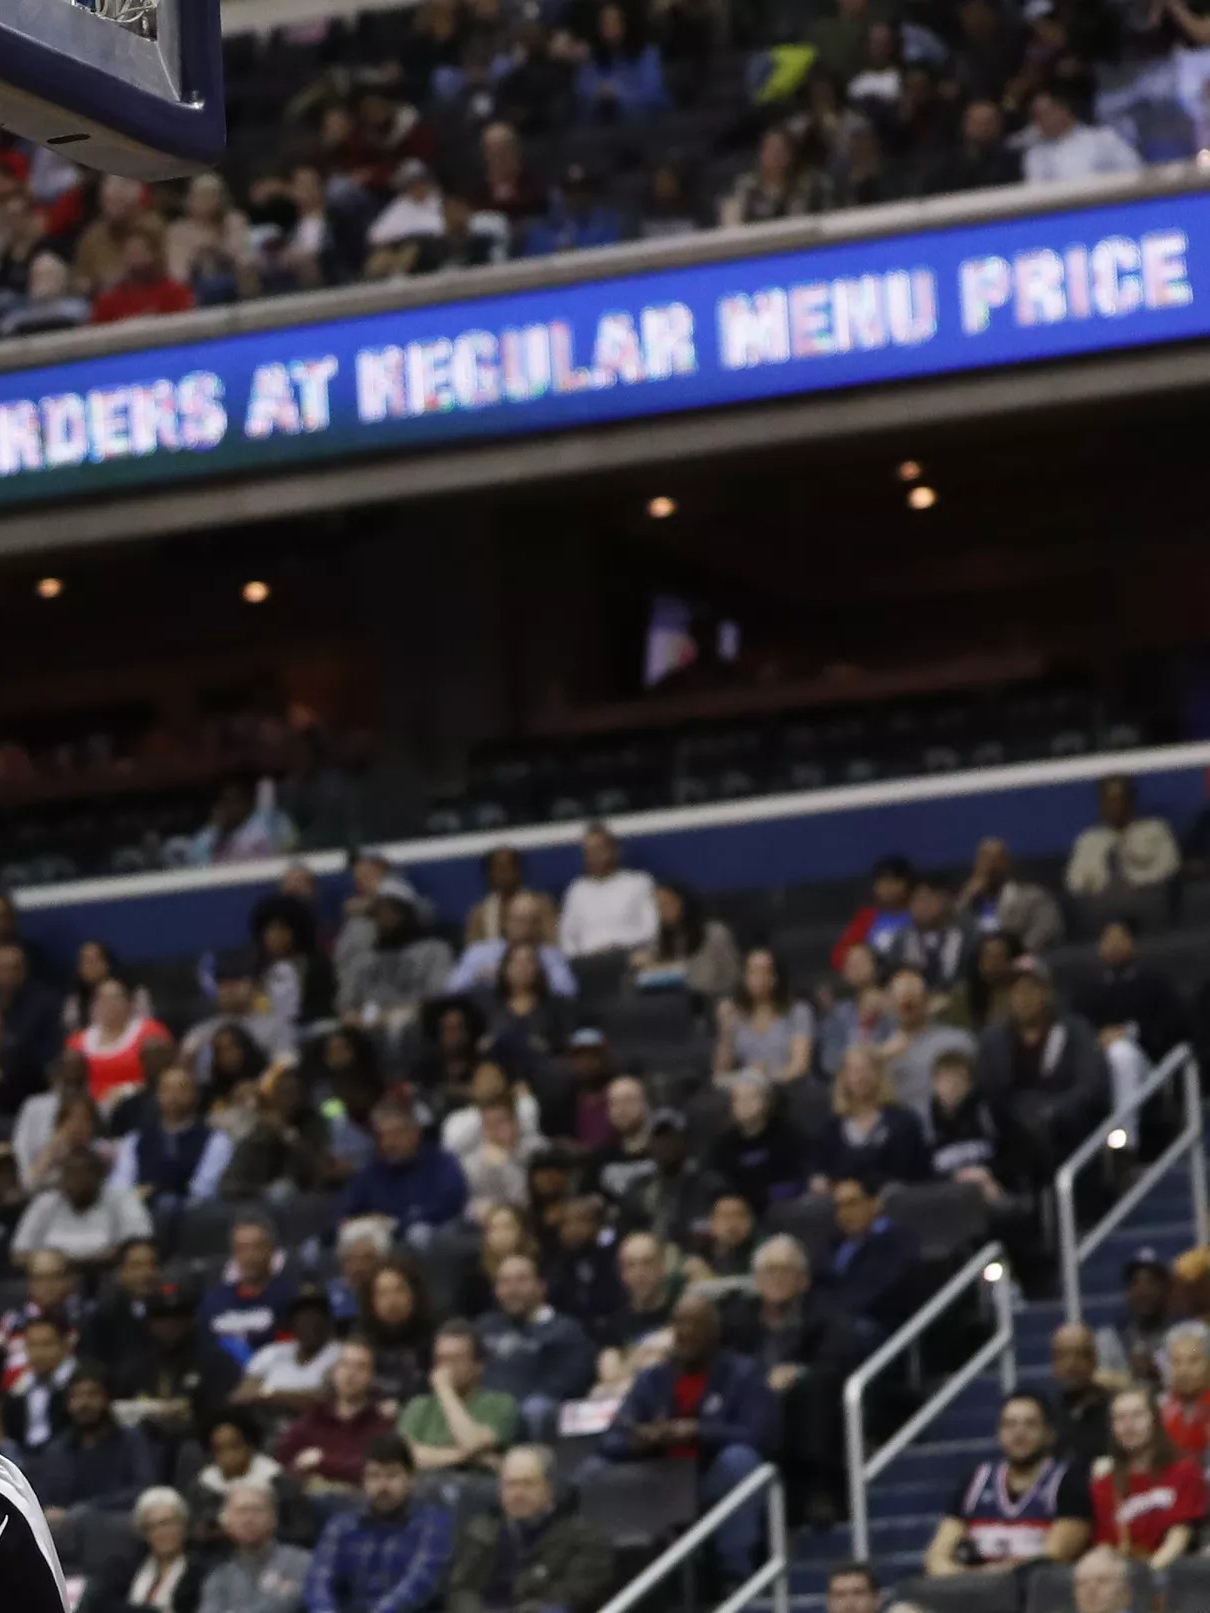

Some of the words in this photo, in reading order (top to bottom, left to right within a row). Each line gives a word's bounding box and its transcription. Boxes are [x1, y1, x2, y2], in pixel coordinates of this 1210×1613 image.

[244, 354, 339, 438] AT
[355, 301, 696, 423] REGULAR
[716, 268, 939, 370] MENU
[958, 229, 1194, 335] PRICE
